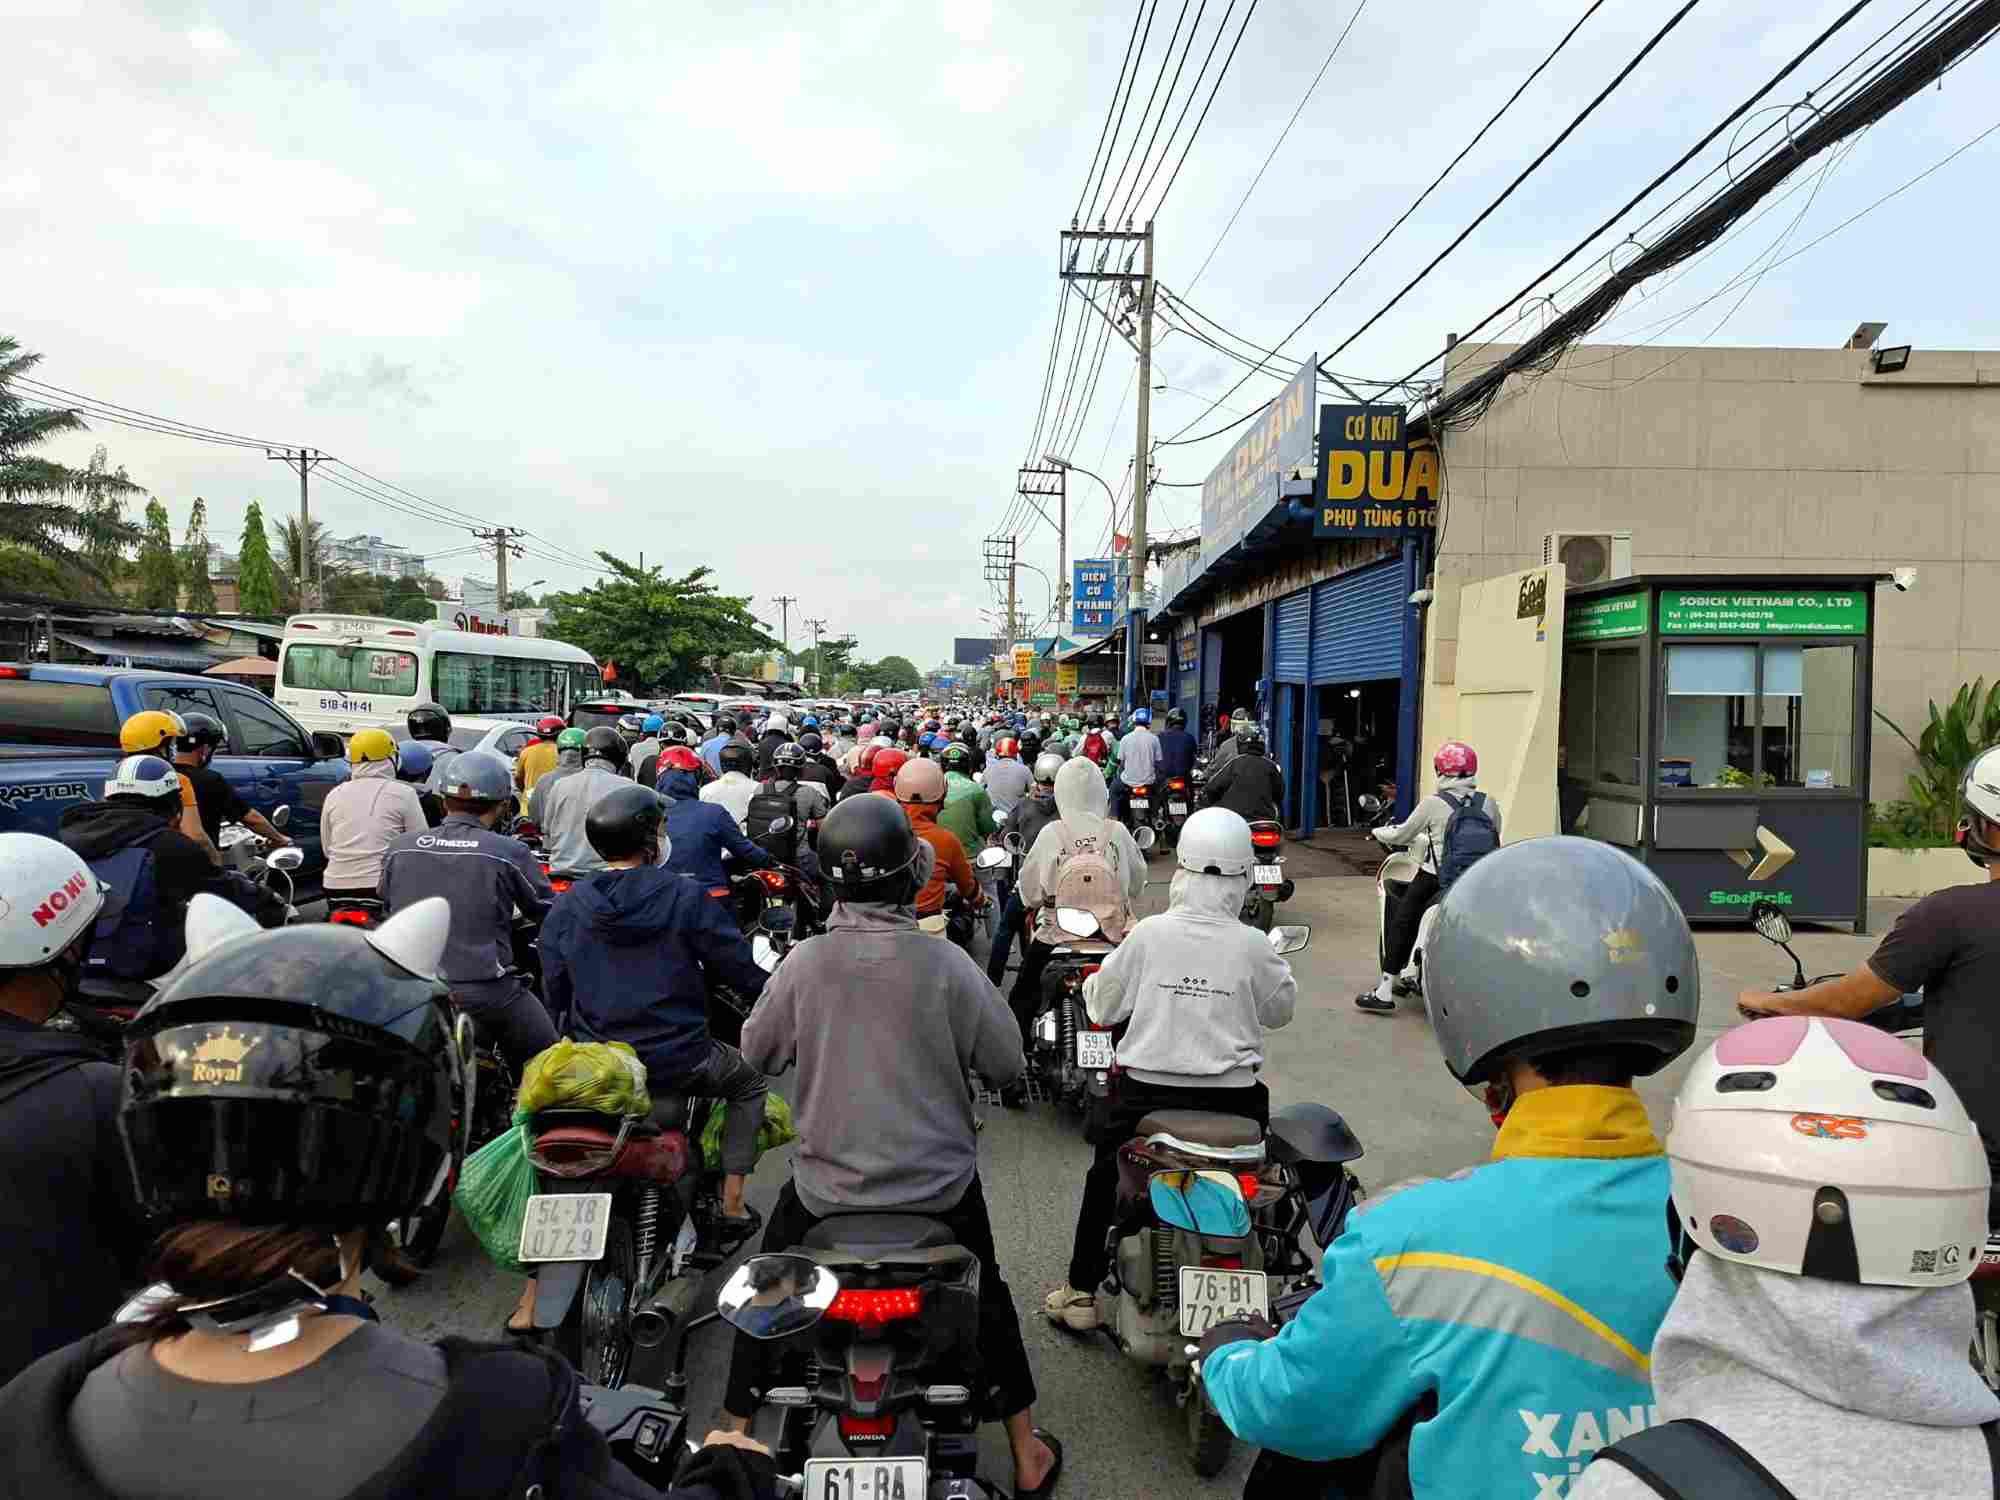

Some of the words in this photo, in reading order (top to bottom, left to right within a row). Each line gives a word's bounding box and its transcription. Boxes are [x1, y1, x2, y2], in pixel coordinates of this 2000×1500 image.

[1323, 509, 1356, 530] PHỤ
[1363, 503, 1402, 527] TÙNG
[1733, 597, 1793, 607] VIETNAM
[1827, 598, 1852, 607] LTD
[191, 1064, 243, 1082] Royal
[849, 1433, 886, 1441] HONDA
